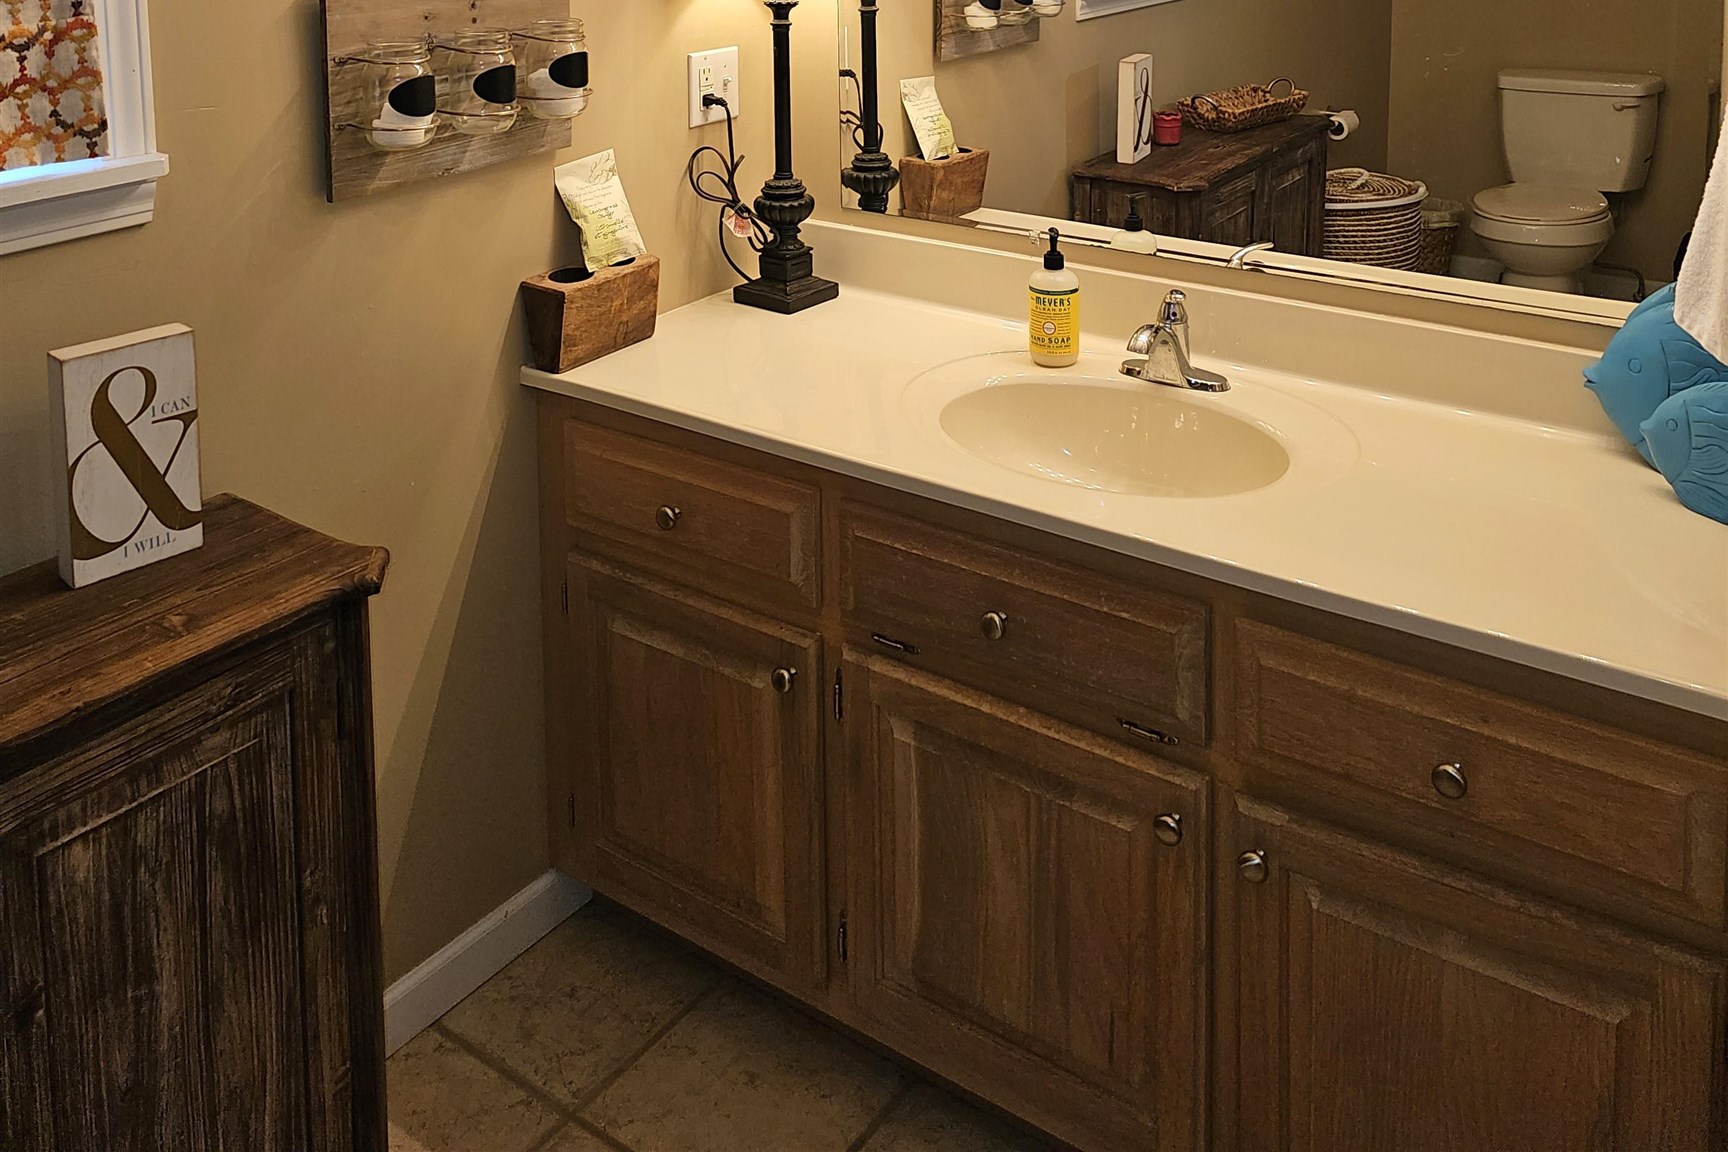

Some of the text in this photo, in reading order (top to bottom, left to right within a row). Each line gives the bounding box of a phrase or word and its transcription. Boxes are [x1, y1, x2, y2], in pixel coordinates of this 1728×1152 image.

[1035, 296, 1071, 307] MEYER'S
[151, 395, 191, 418] I CAN
[123, 532, 177, 558] I WILL
